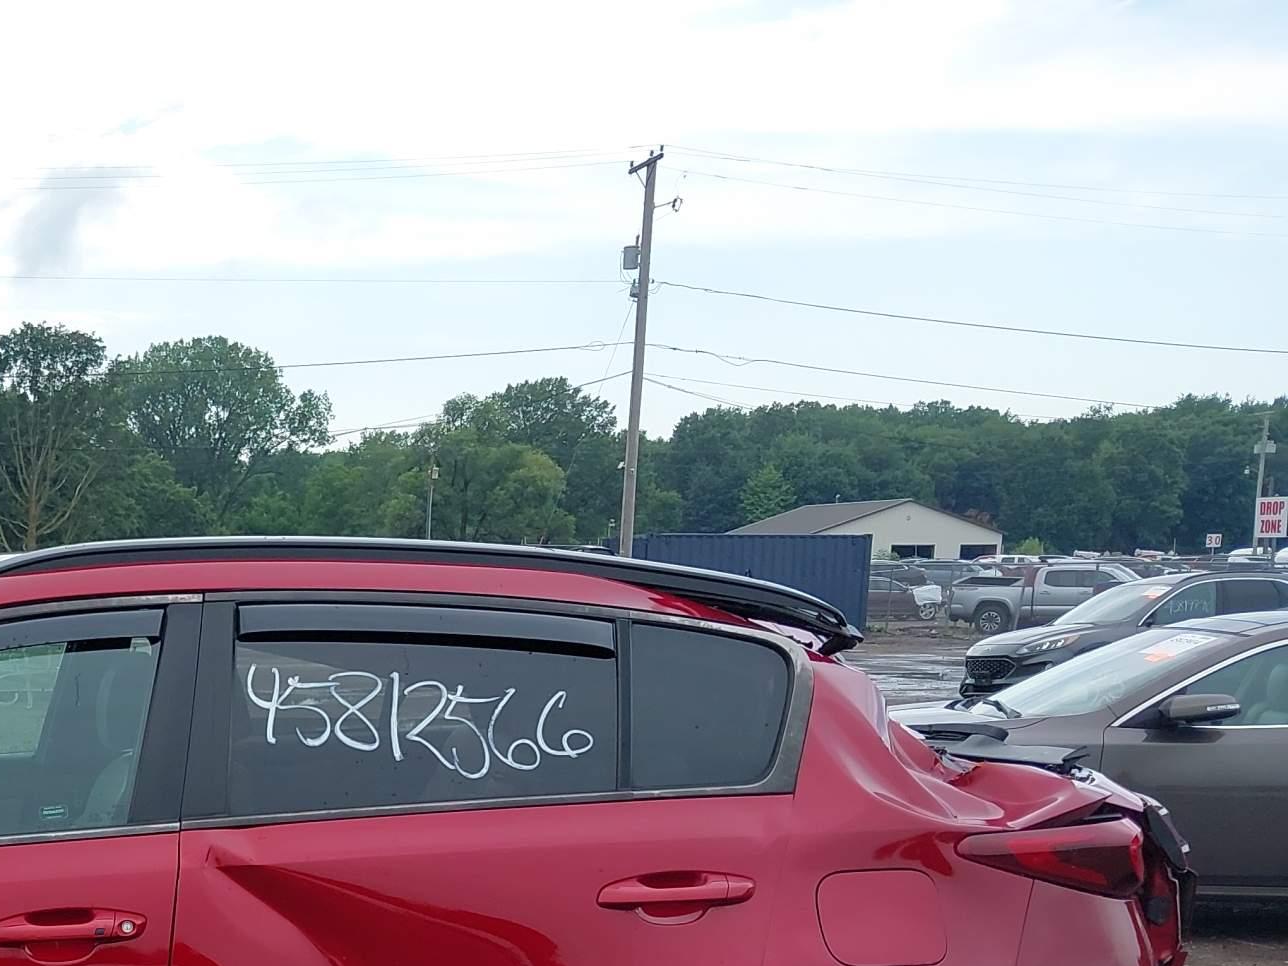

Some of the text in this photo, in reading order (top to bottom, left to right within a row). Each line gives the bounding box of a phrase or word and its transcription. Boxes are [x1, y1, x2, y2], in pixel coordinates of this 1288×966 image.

[1259, 501, 1285, 516] DROP
[1259, 519, 1282, 534] ZONE
[1207, 535, 1221, 545] 30
[246, 663, 594, 779] 45812566
